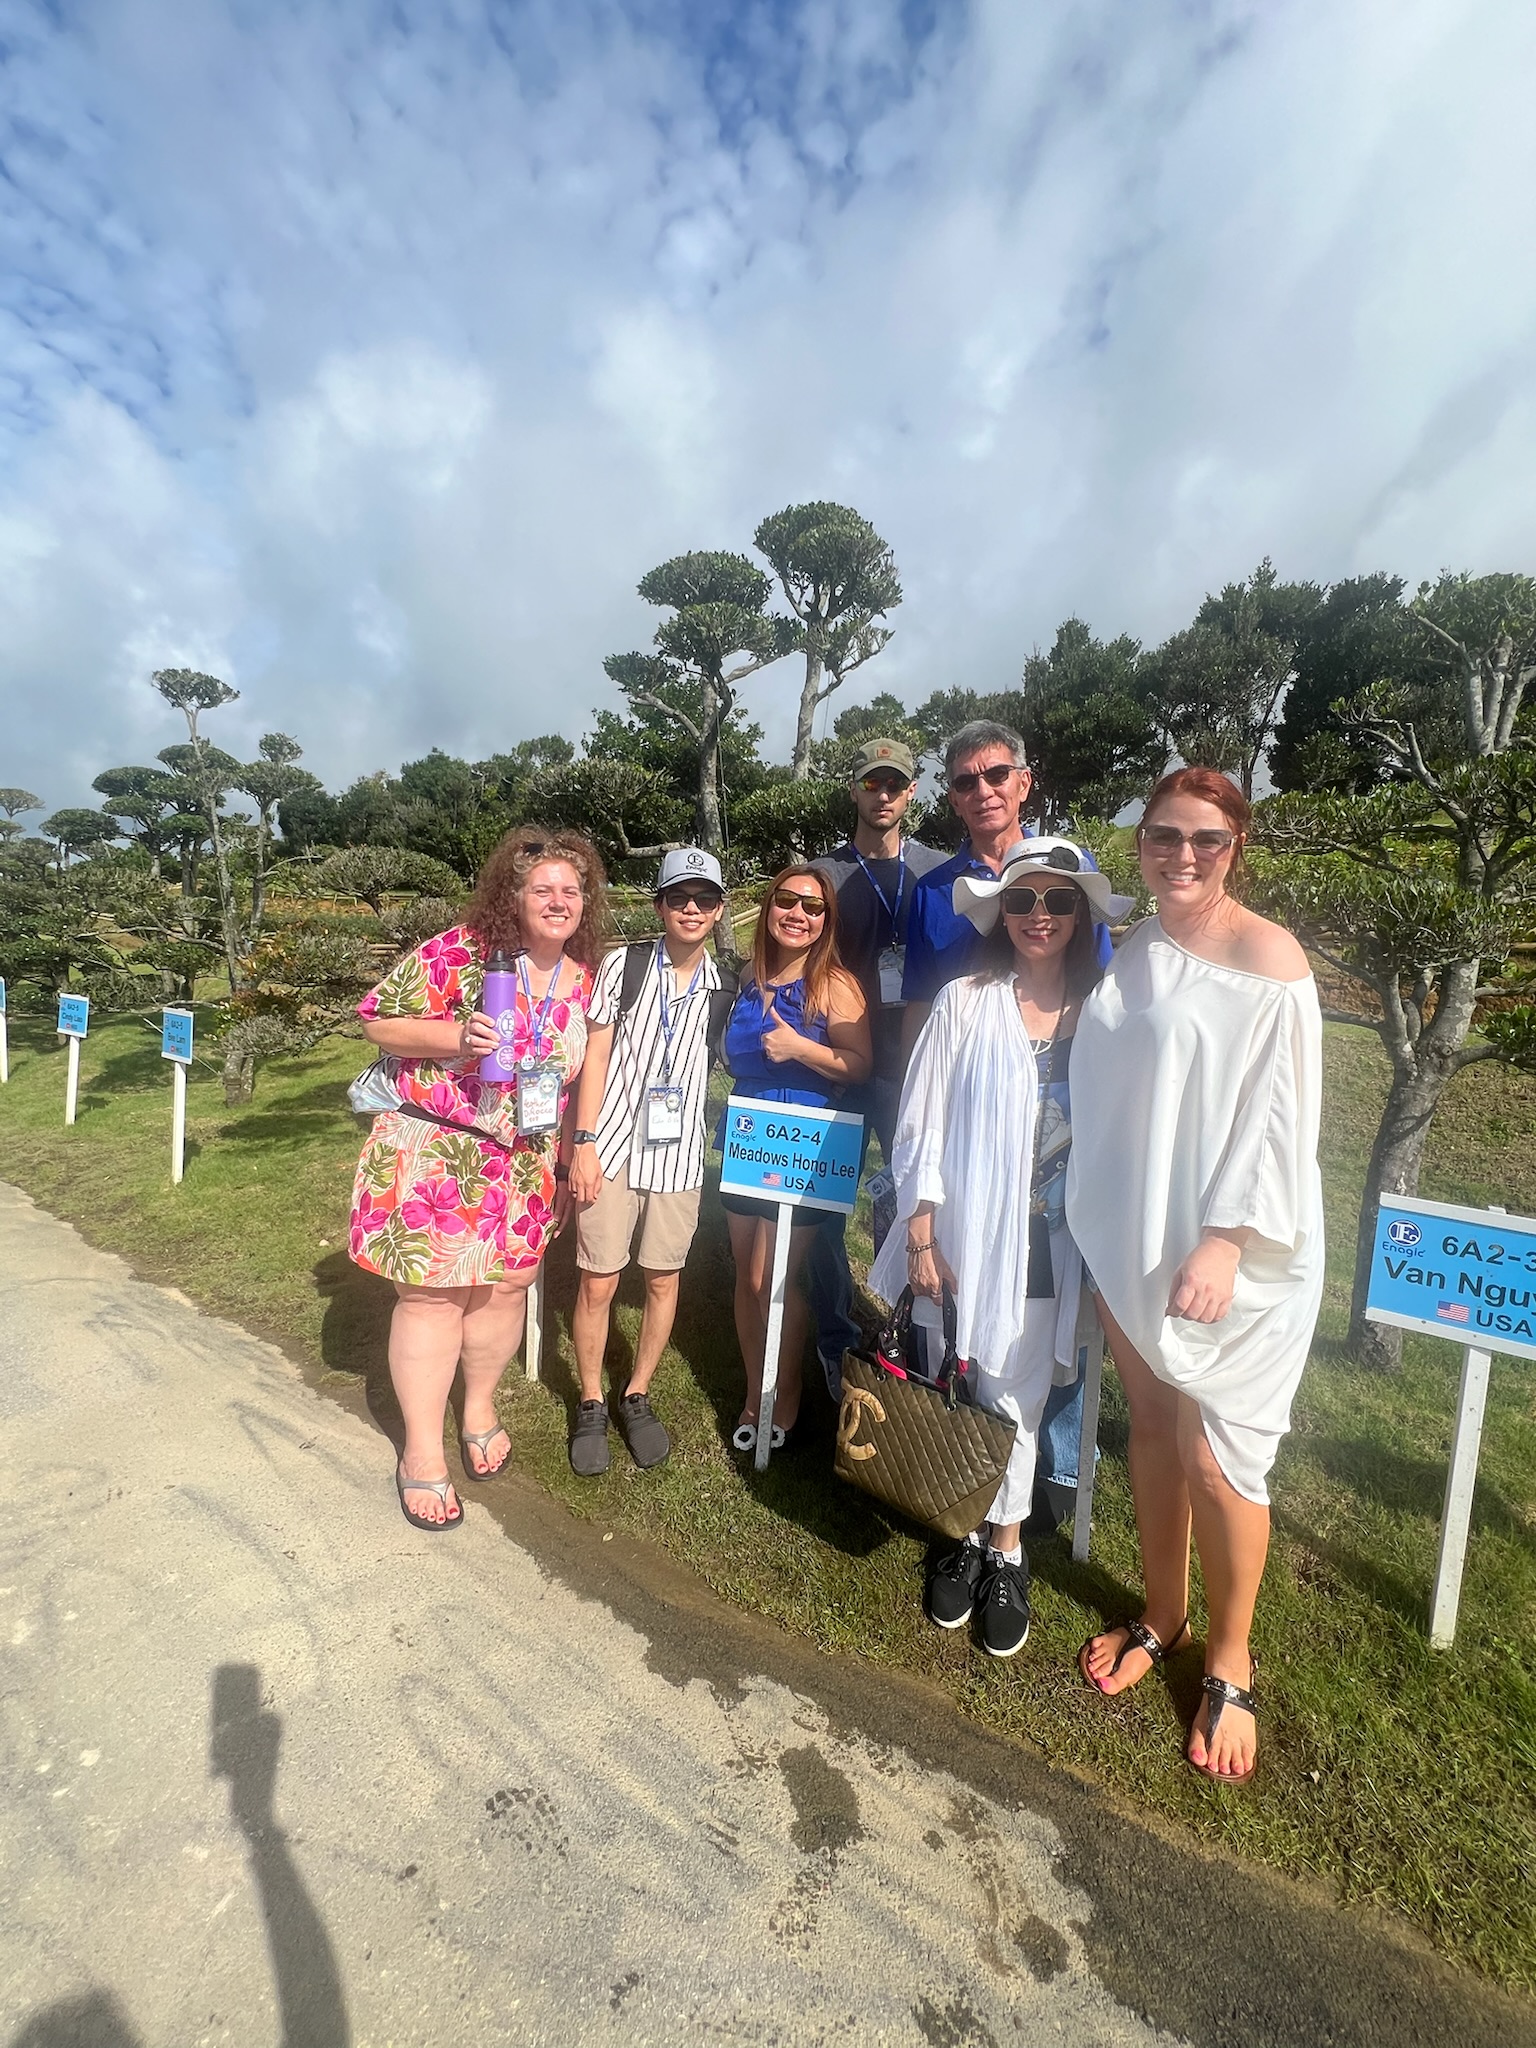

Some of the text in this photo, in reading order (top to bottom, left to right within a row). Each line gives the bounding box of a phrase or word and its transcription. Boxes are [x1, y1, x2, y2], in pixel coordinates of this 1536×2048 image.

[731, 1130, 757, 1142] Enagic
[766, 1123, 821, 1146] 6A2-4
[728, 1142, 855, 1179] Meadows Hong Lee
[784, 1175, 816, 1193] USA
[1382, 1241, 1426, 1258] Enagic
[1442, 1236, 1536, 1272] 6A2-3
[1384, 1256, 1446, 1290] Van
[1476, 1309, 1533, 1338] USA
